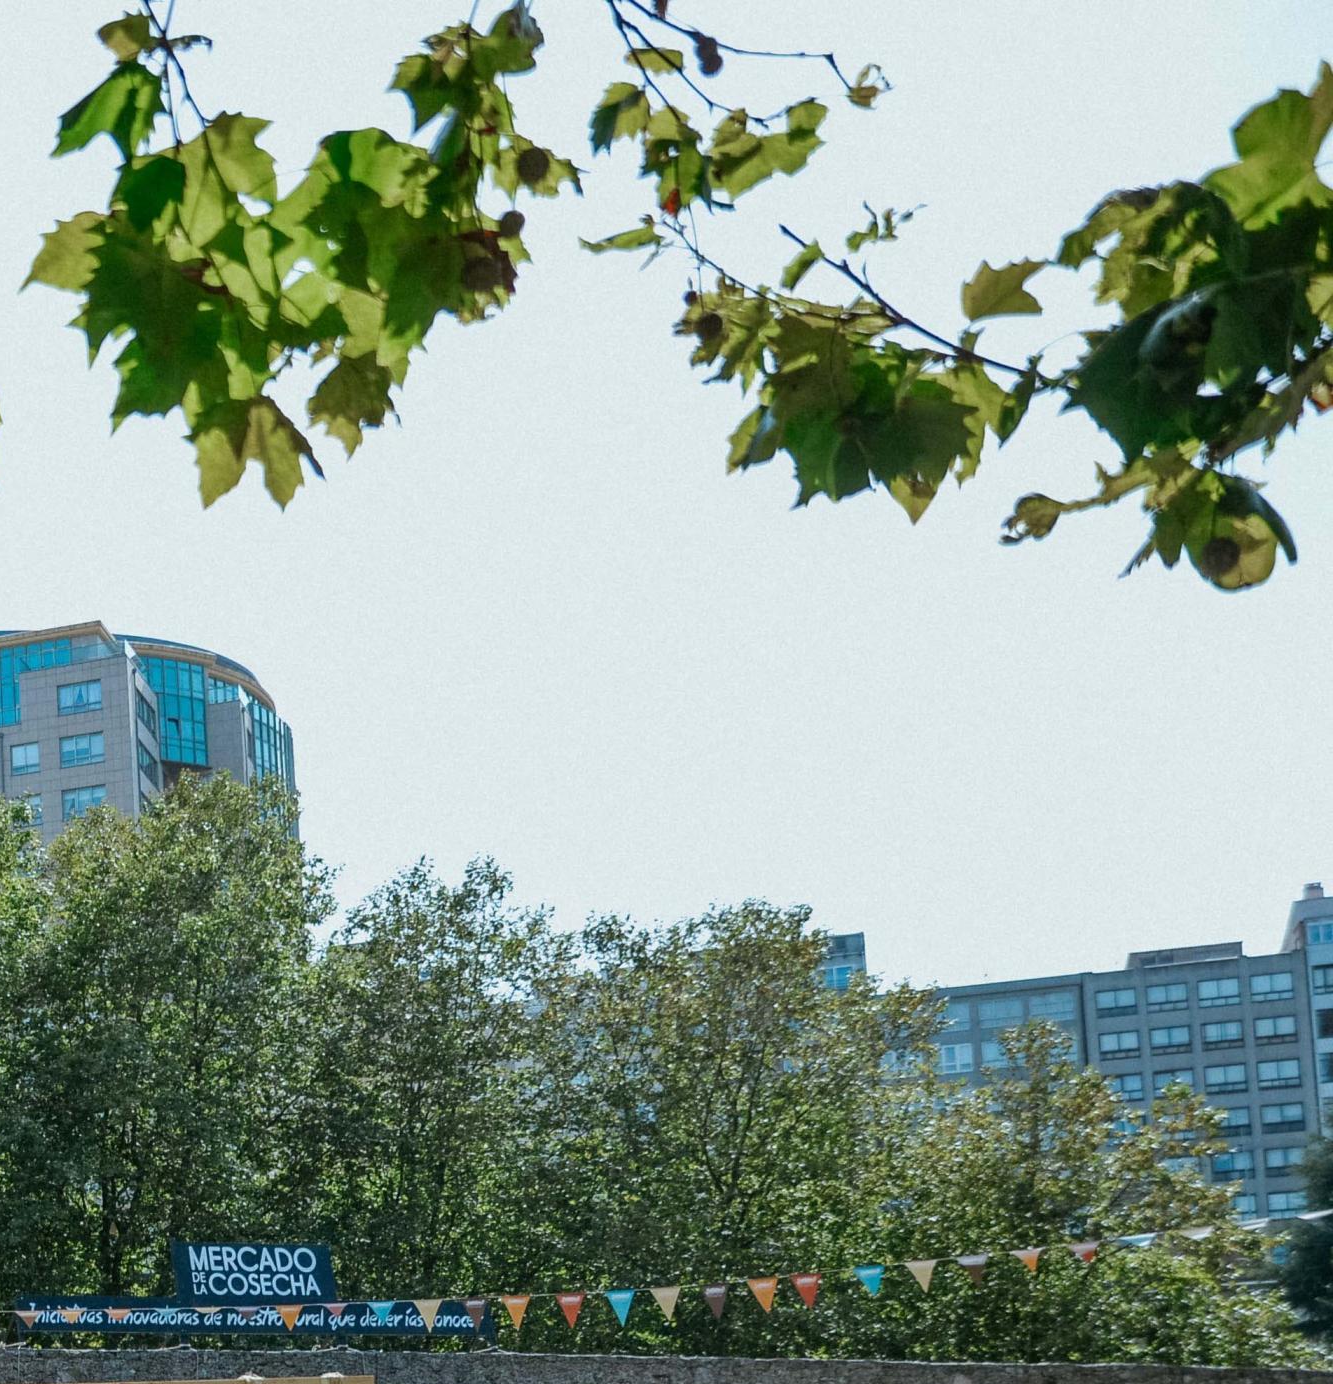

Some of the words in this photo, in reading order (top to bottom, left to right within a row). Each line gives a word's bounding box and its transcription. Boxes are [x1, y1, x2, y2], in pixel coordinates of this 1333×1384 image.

[188, 1246, 317, 1272] MERCADO
[192, 1272, 207, 1283] DE
[208, 1273, 322, 1296] COSECHA
[193, 1284, 208, 1295] LA
[107, 1304, 200, 1325] inovadoras
[203, 1306, 222, 1326] de
[294, 1307, 323, 1327] ural
[327, 1312, 355, 1330] que
[360, 1306, 424, 1327] deerías
